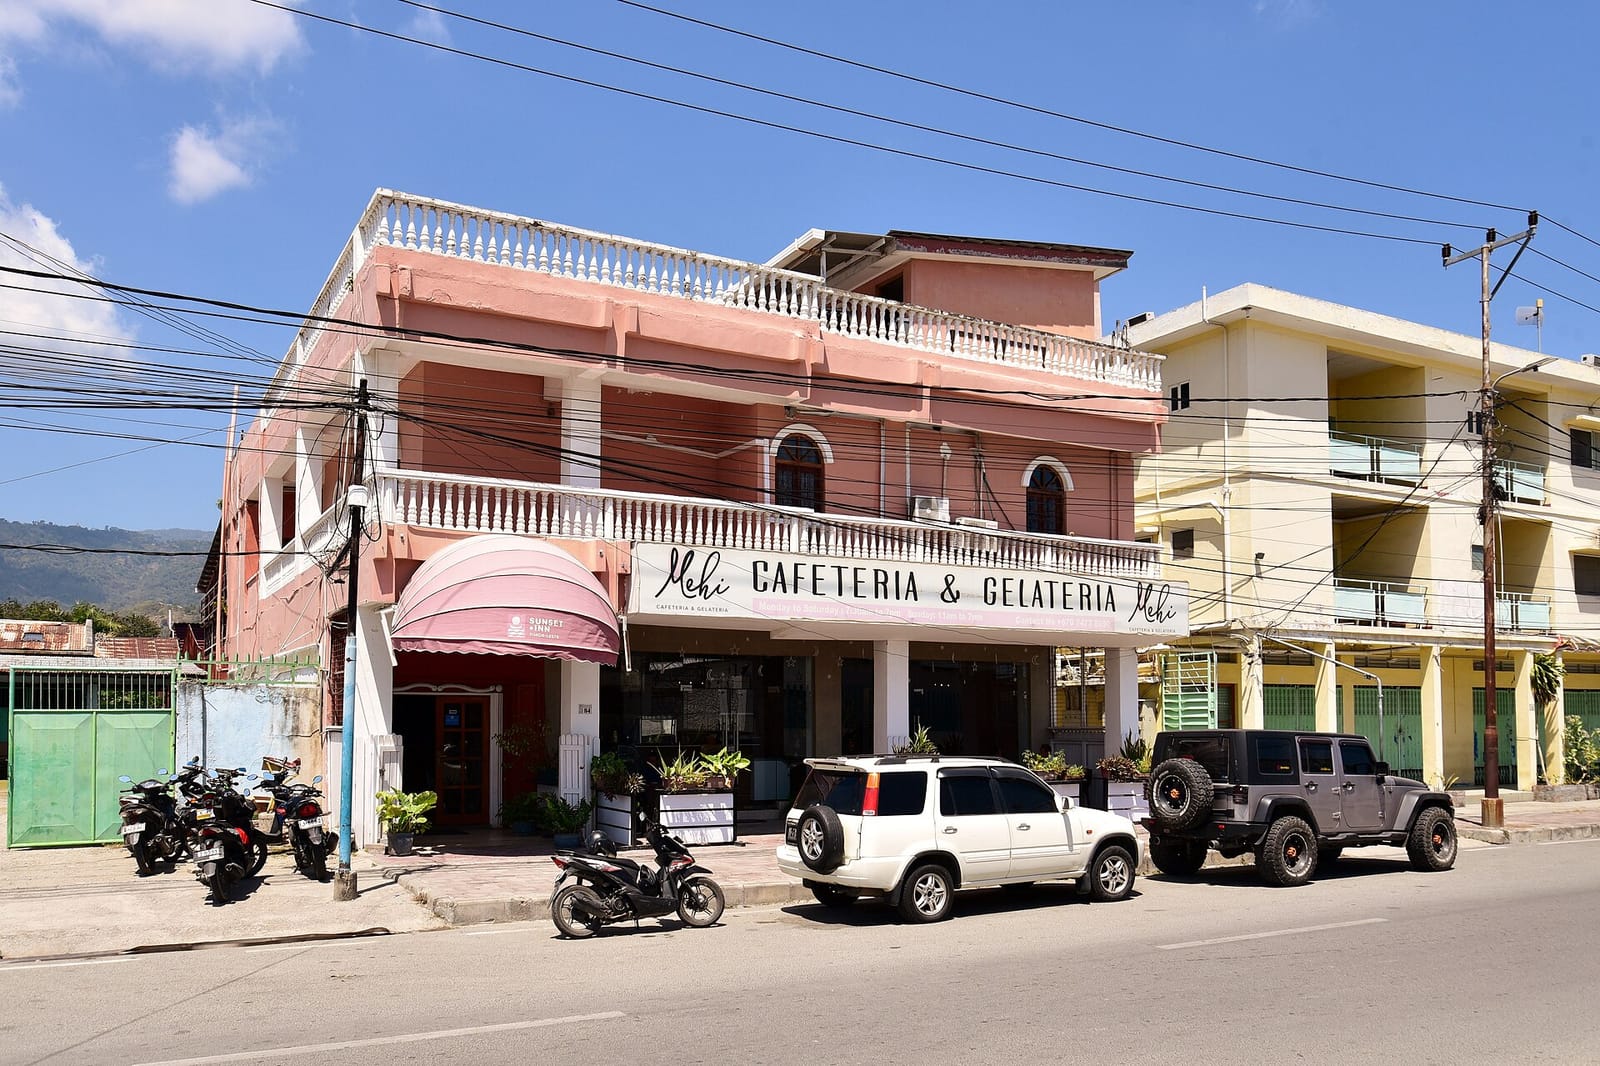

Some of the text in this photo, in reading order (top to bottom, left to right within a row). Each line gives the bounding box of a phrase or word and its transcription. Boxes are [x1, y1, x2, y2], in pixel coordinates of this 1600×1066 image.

[655, 547, 730, 600] Mehi
[752, 560, 1116, 612] CAFETERIA & GELATERIA
[529, 617, 563, 628] SUNSET
[759, 601, 793, 613] Monday
[1128, 581, 1176, 624] Mehi
